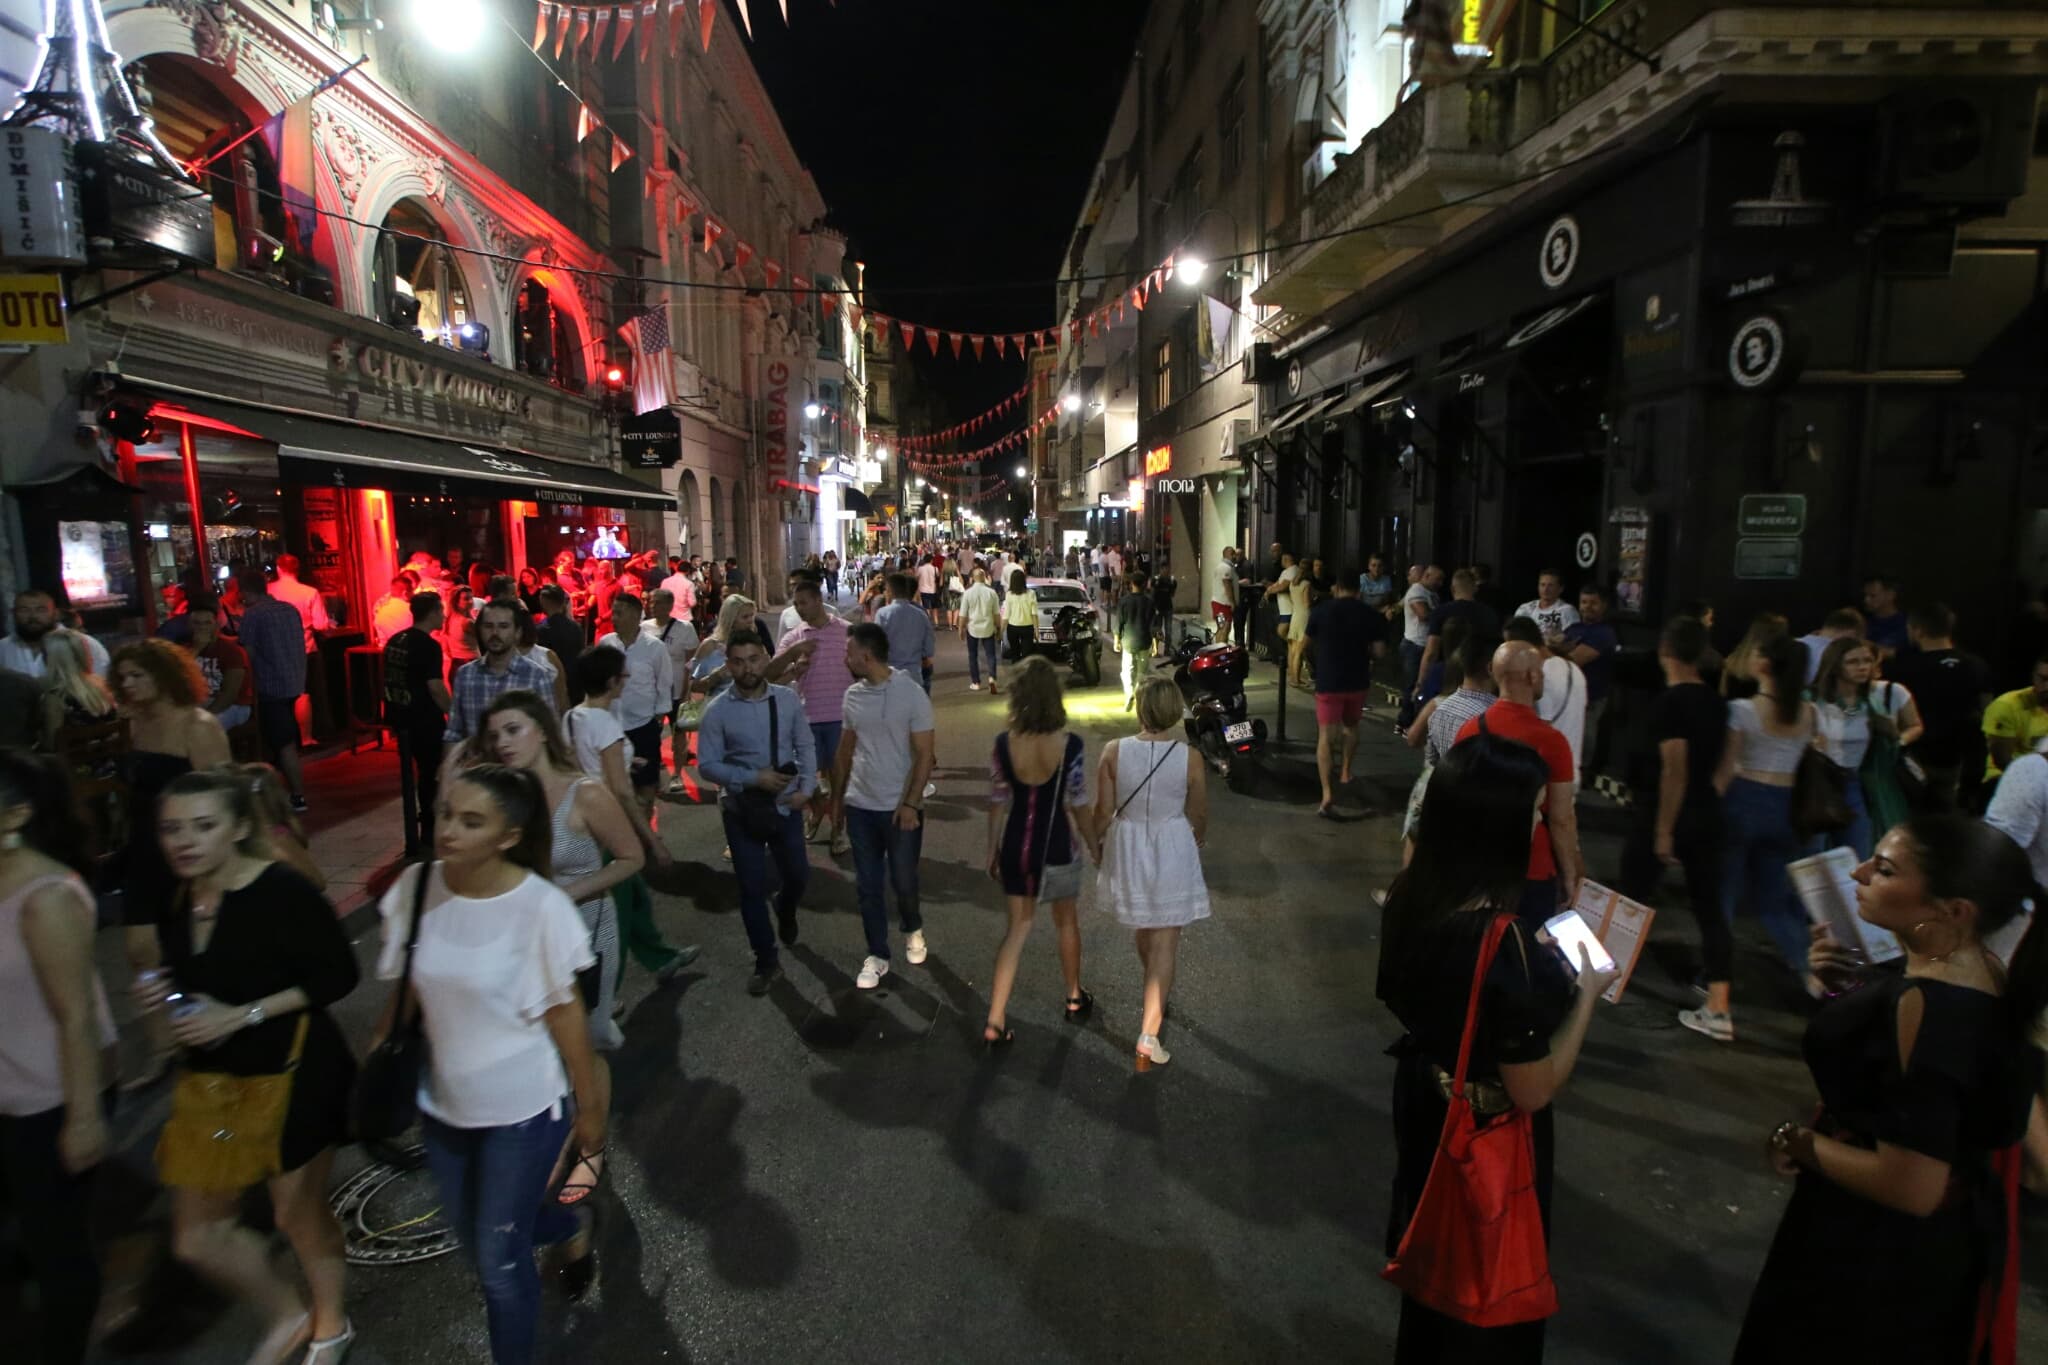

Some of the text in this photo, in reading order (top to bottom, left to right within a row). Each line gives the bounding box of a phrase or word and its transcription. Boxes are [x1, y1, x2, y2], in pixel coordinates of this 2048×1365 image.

[358, 345, 520, 417] CITY LOUNGE
[627, 432, 642, 440] CITY
[766, 361, 789, 495] STRABAG
